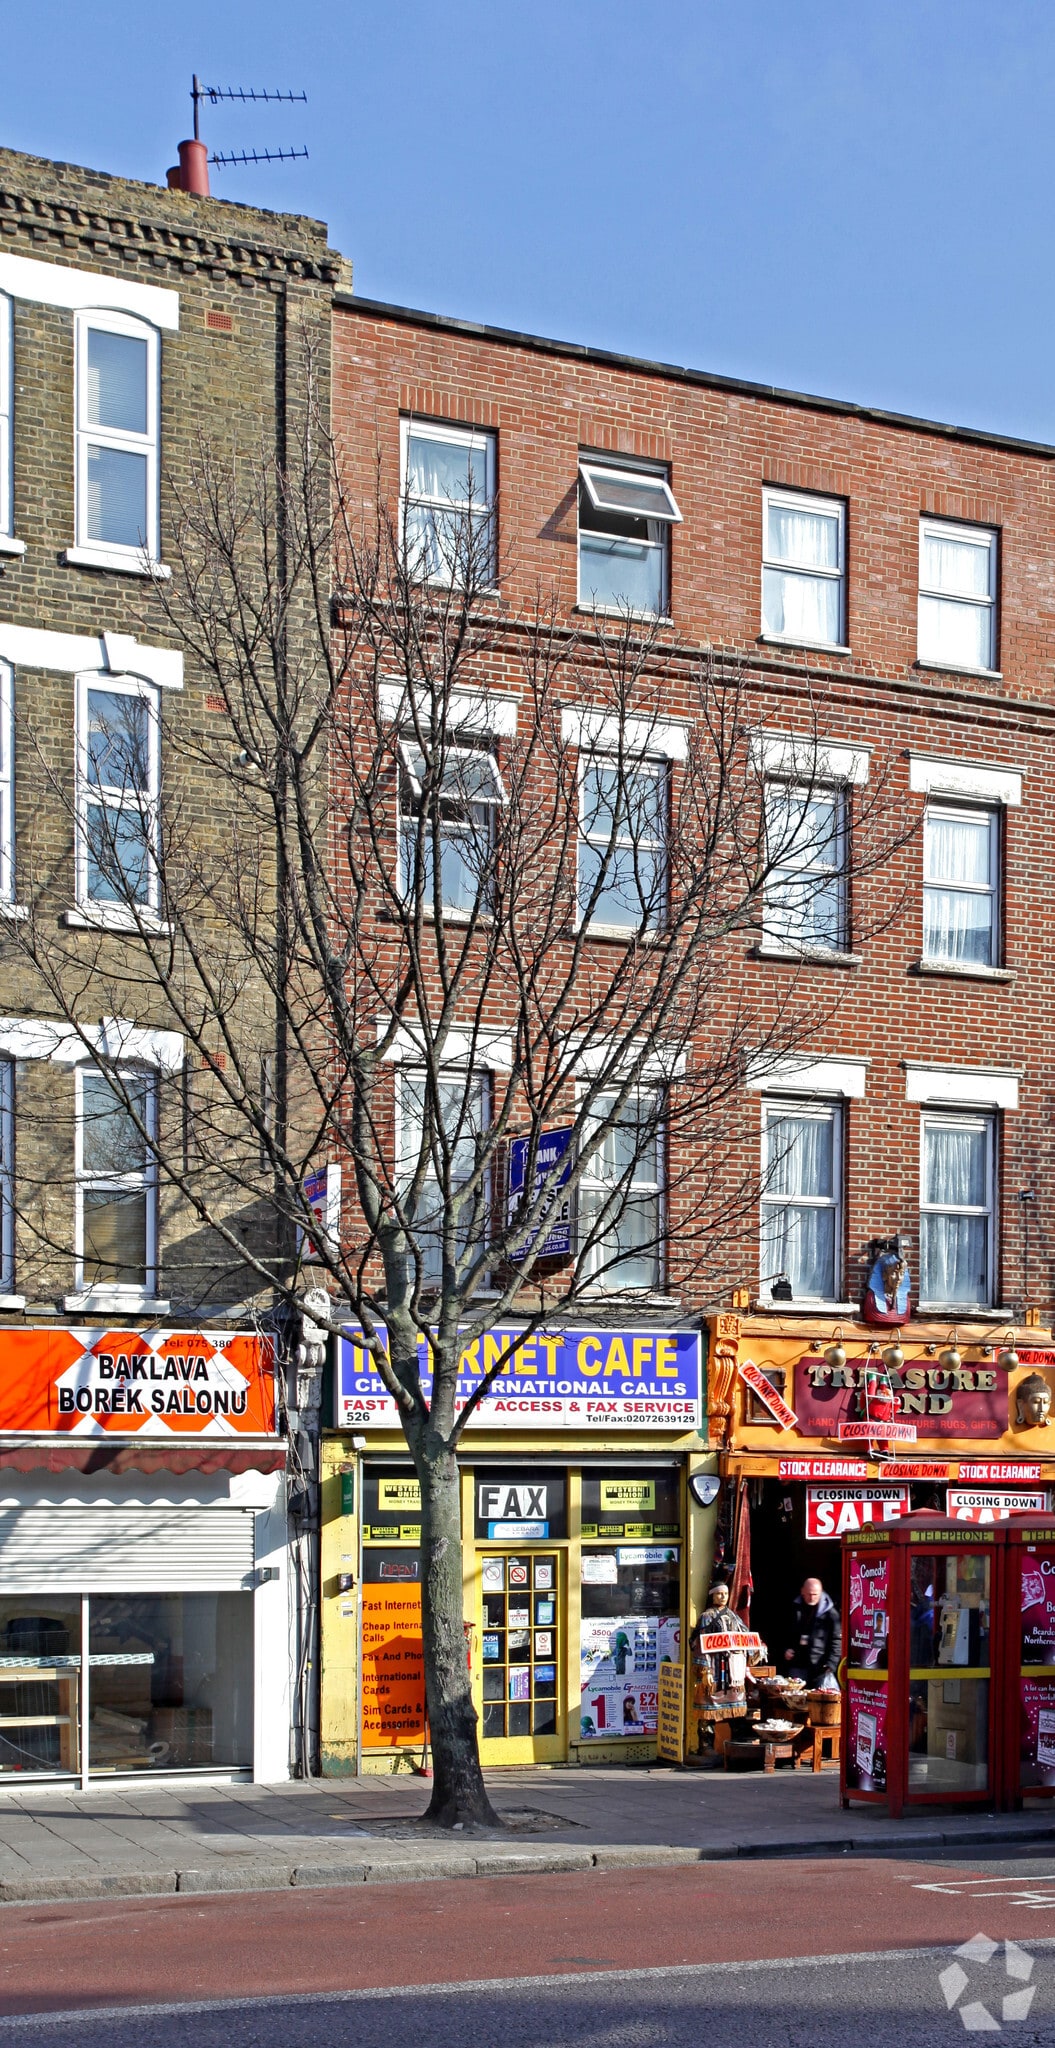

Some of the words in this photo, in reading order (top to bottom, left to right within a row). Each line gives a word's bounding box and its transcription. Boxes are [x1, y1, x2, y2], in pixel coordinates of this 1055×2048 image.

[163, 1339, 183, 1347] Tel:
[187, 1340, 208, 1348] 075
[212, 1340, 232, 1348] 380
[577, 1335, 678, 1378] CAFE
[100, 1355, 209, 1381] BAKLAVA
[620, 1381, 687, 1396] CALLS
[59, 1385, 143, 1413] BÖREK
[151, 1388, 247, 1414] SALONU
[343, 1400, 388, 1411] FAST
[494, 1401, 563, 1412] ACCESS
[569, 1401, 581, 1412] &
[586, 1402, 618, 1413] FAX
[623, 1402, 694, 1413] SERVICE
[346, 1411, 370, 1422] 526
[586, 1414, 695, 1423] Tel/Fax:02072639129
[808, 1417, 834, 1427] HAND
[971, 1420, 997, 1429] GIFTS
[843, 1425, 882, 1437] CLOSING
[780, 1461, 811, 1475] STOCK
[813, 1462, 867, 1477] CLEARANCE
[883, 1463, 919, 1477] CLOSING
[921, 1464, 947, 1477] DOWN
[959, 1465, 988, 1478] STOCK
[990, 1466, 1041, 1479] CLEARANCE
[817, 1490, 862, 1500] CLOSING
[867, 1489, 900, 1499] DOWN
[481, 1487, 545, 1517] FAX
[957, 1496, 1000, 1506] CLOSING
[1004, 1497, 1037, 1508] DOWN
[849, 1532, 887, 1543] TELEPHONE
[916, 1531, 989, 1541] TELEPHONE
[620, 1550, 663, 1560] Lycamobile
[383, 1564, 413, 1575] OPEN
[860, 1561, 887, 1580] Comedy!
[869, 1581, 888, 1604] Boys!
[362, 1601, 382, 1610] Fast
[385, 1600, 422, 1610] Internet
[363, 1622, 390, 1632] Cheap
[363, 1633, 385, 1642] Calls
[591, 1629, 612, 1637] 3500
[362, 1653, 379, 1661] Fax
[382, 1652, 401, 1661] And
[362, 1672, 421, 1682] International
[363, 1685, 391, 1695] Cards
[588, 1685, 622, 1693] Lycamobile
[363, 1705, 382, 1715] Sim
[384, 1703, 412, 1714] Cards
[415, 1703, 422, 1713] &
[363, 1718, 421, 1730] Accessories
